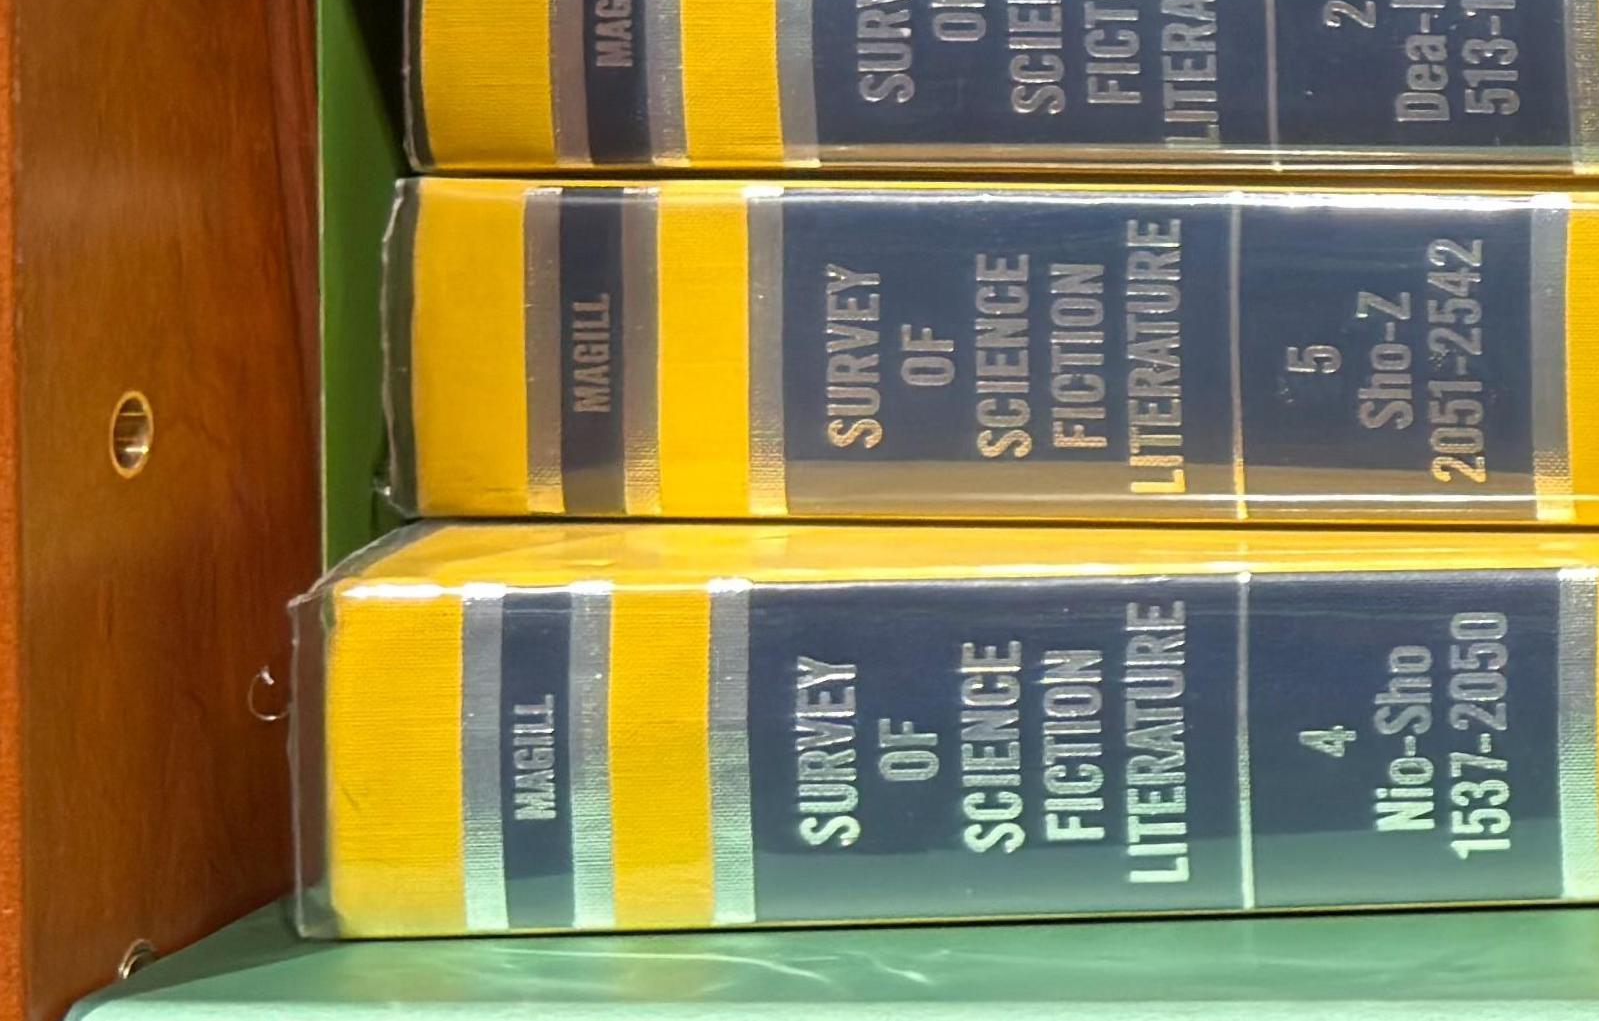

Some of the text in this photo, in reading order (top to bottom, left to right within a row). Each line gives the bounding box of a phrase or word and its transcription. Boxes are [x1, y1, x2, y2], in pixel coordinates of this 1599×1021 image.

[1323, 0, 1377, 28] 2
[572, 293, 612, 414] MAGILL
[826, 262, 884, 448] SURVEY
[901, 322, 955, 386] OF
[974, 252, 1033, 460] SCIENCE
[1050, 261, 1105, 450] FICTION
[1127, 217, 1185, 494] LITERATURE
[1286, 345, 1343, 377] 5
[1357, 292, 1412, 433] Sho-Z
[1428, 238, 1488, 486] 2051-2542
[514, 694, 556, 823] MAGILL
[799, 654, 860, 849] SURVEY
[879, 719, 940, 783] OF
[962, 638, 1027, 855] SCIENCE
[1044, 649, 1105, 843] FICTION
[1127, 600, 1189, 886] LITERATURE
[1298, 725, 1358, 757] 4
[1373, 645, 1436, 832] Nio-Sho
[1448, 610, 1511, 859] 1537-2050
